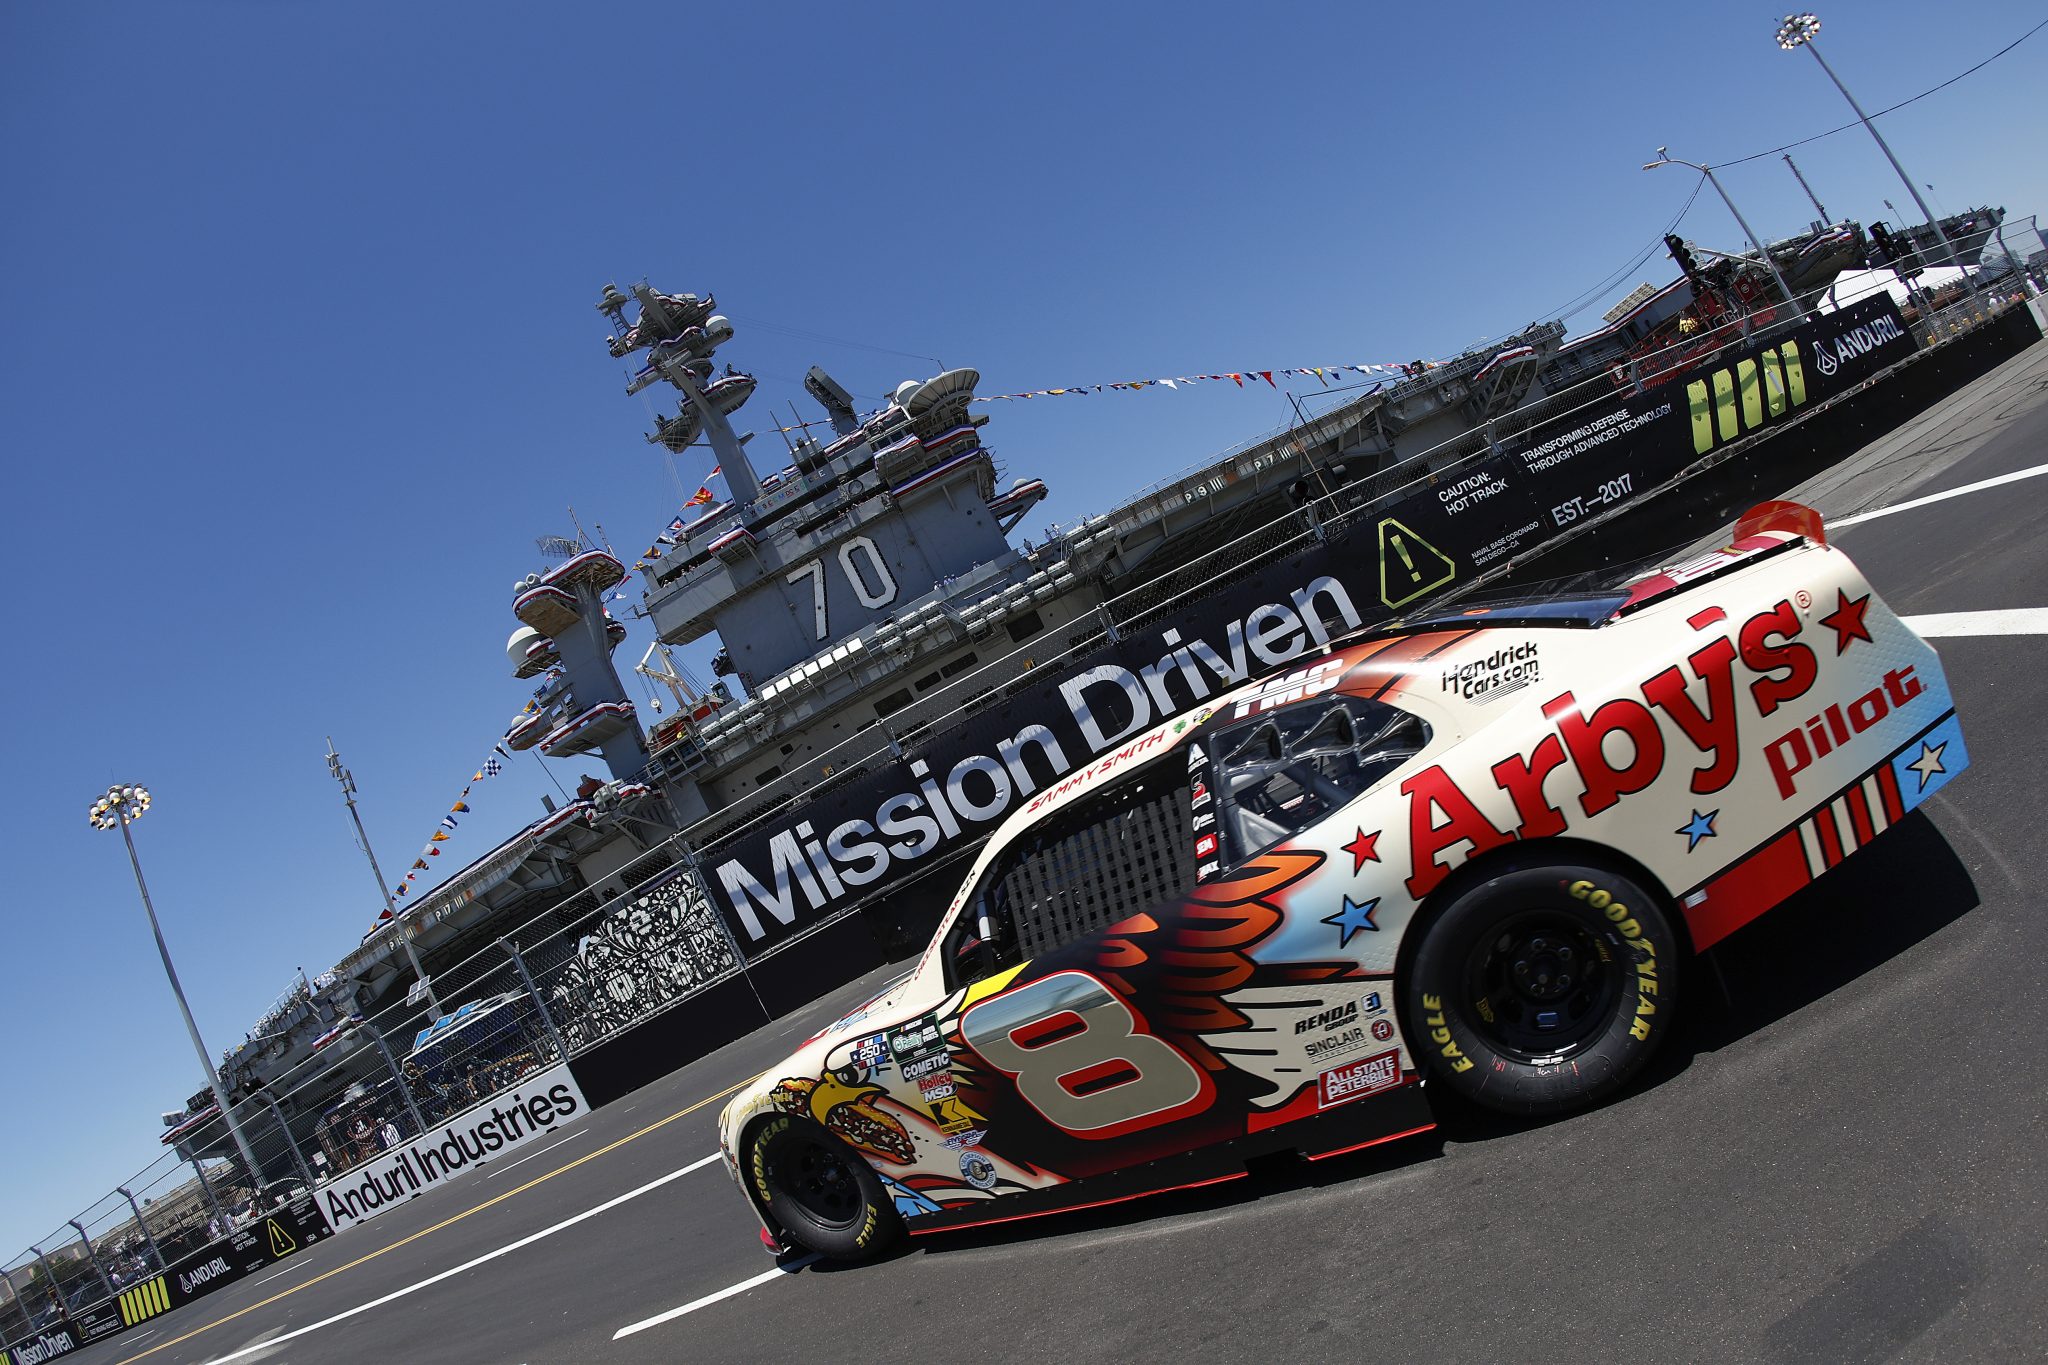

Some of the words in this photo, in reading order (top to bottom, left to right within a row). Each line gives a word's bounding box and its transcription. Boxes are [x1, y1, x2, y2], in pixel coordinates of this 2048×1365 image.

[1834, 314, 1904, 363] ANDURIL
[1521, 425, 1593, 462] TRANSFORMING
[1590, 408, 1630, 434] DEFENSE
[1527, 448, 1579, 474] THROUGH
[1574, 428, 1620, 455] ADVANCED
[1618, 403, 1672, 433] TECHNOLOGY
[1438, 472, 1491, 502] CAUTION:
[1445, 496, 1470, 516] HOT
[1469, 478, 1509, 506] TRACK
[1471, 544, 1492, 559] NAVAL
[1489, 535, 1508, 551] BASE
[1503, 521, 1539, 545] CORONADO
[1474, 553, 1489, 566] SAN
[786, 536, 900, 641] 70
[1442, 642, 1538, 694] Hendrick
[1463, 659, 1539, 699] Cars.com
[1228, 658, 1344, 719] TMC
[1763, 664, 1922, 801] pilot
[714, 724, 1071, 942] Mission
[1059, 575, 1362, 754] Driven
[1027, 766, 1100, 814] SAMMY
[1098, 730, 1166, 775] SMITH
[1569, 880, 1658, 1042] GOODYEAR
[1295, 1001, 1358, 1035] RENDA
[1325, 1014, 1358, 1032] GROUP
[1423, 993, 1474, 1073] EAGLE
[860, 1045, 880, 1060] 250
[960, 968, 1214, 1139] 8
[1305, 1028, 1364, 1056] SINCLAIR
[902, 1052, 950, 1079] COMETIC
[918, 1072, 953, 1092] Holley
[1327, 1067, 1396, 1101] PETERBILT
[924, 1083, 953, 1102] MSD
[326, 1153, 421, 1226] Anduril
[411, 1084, 577, 1183] Industries
[754, 1117, 789, 1201] GOODYEAR
[306, 1233, 318, 1243] USA
[855, 1203, 877, 1249] EAGLE
[190, 1256, 231, 1288] ANDURIL
[13, 1341, 46, 1365] Mission
[39, 1331, 74, 1358] Driven
